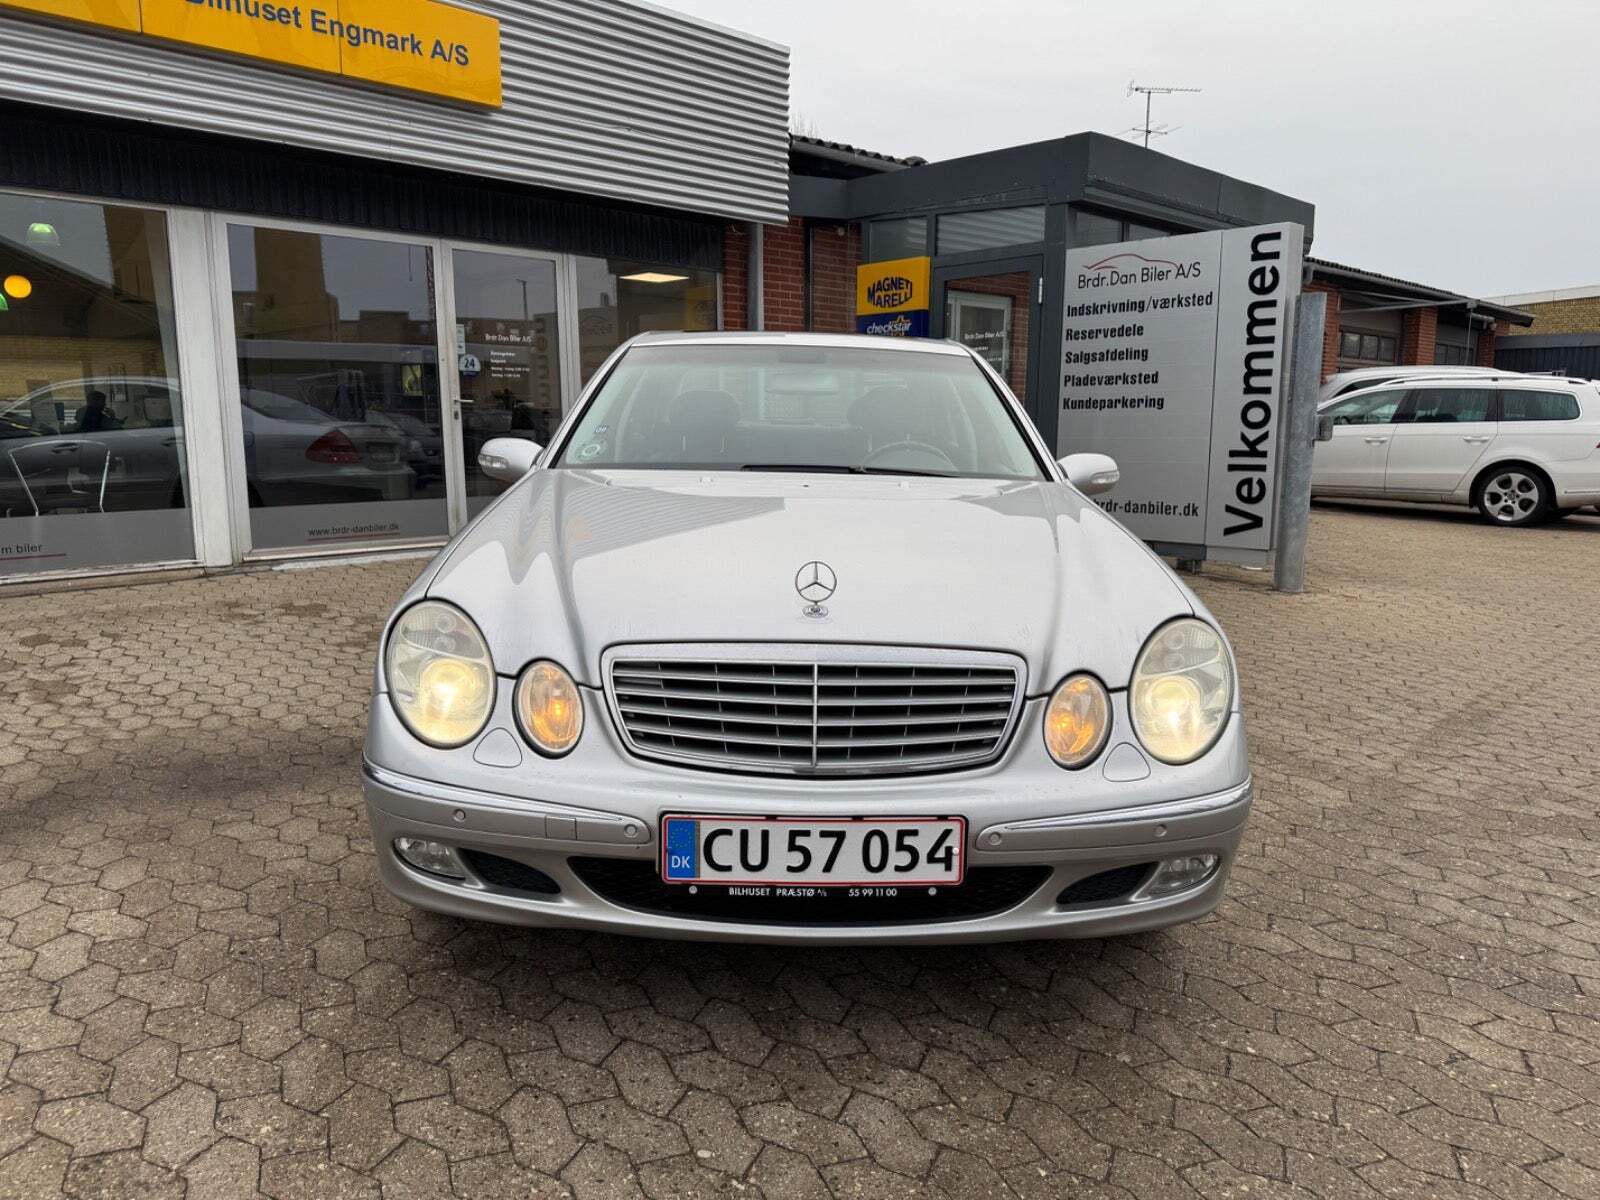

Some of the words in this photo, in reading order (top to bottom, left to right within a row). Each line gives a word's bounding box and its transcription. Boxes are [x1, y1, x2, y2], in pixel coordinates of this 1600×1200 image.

[186, 0, 302, 28] huset
[310, 9, 423, 56] Engmark
[431, 39, 469, 66] A/S
[1141, 266, 1171, 282] Biler
[1175, 261, 1201, 279] A/S
[1067, 291, 1213, 317] Indskrivning/værksted
[1066, 324, 1144, 340] Reservedele
[464, 358, 475, 368] 24
[1065, 347, 1149, 364] Salgsafdeling
[1064, 371, 1159, 387] Pladeværksted
[1223, 231, 1282, 536] Velkommen
[1063, 395, 1165, 411] Kundeparkering
[16, 543, 42, 553] biler
[703, 828, 770, 872] CU
[786, 829, 847, 873] 57
[862, 828, 953, 873] 054
[671, 855, 691, 868] DK
[729, 887, 770, 896] BILHUSET
[776, 888, 815, 897] PRÆSTØ
[849, 888, 860, 897] 55
[862, 888, 873, 897] 99
[886, 888, 897, 897] 00
